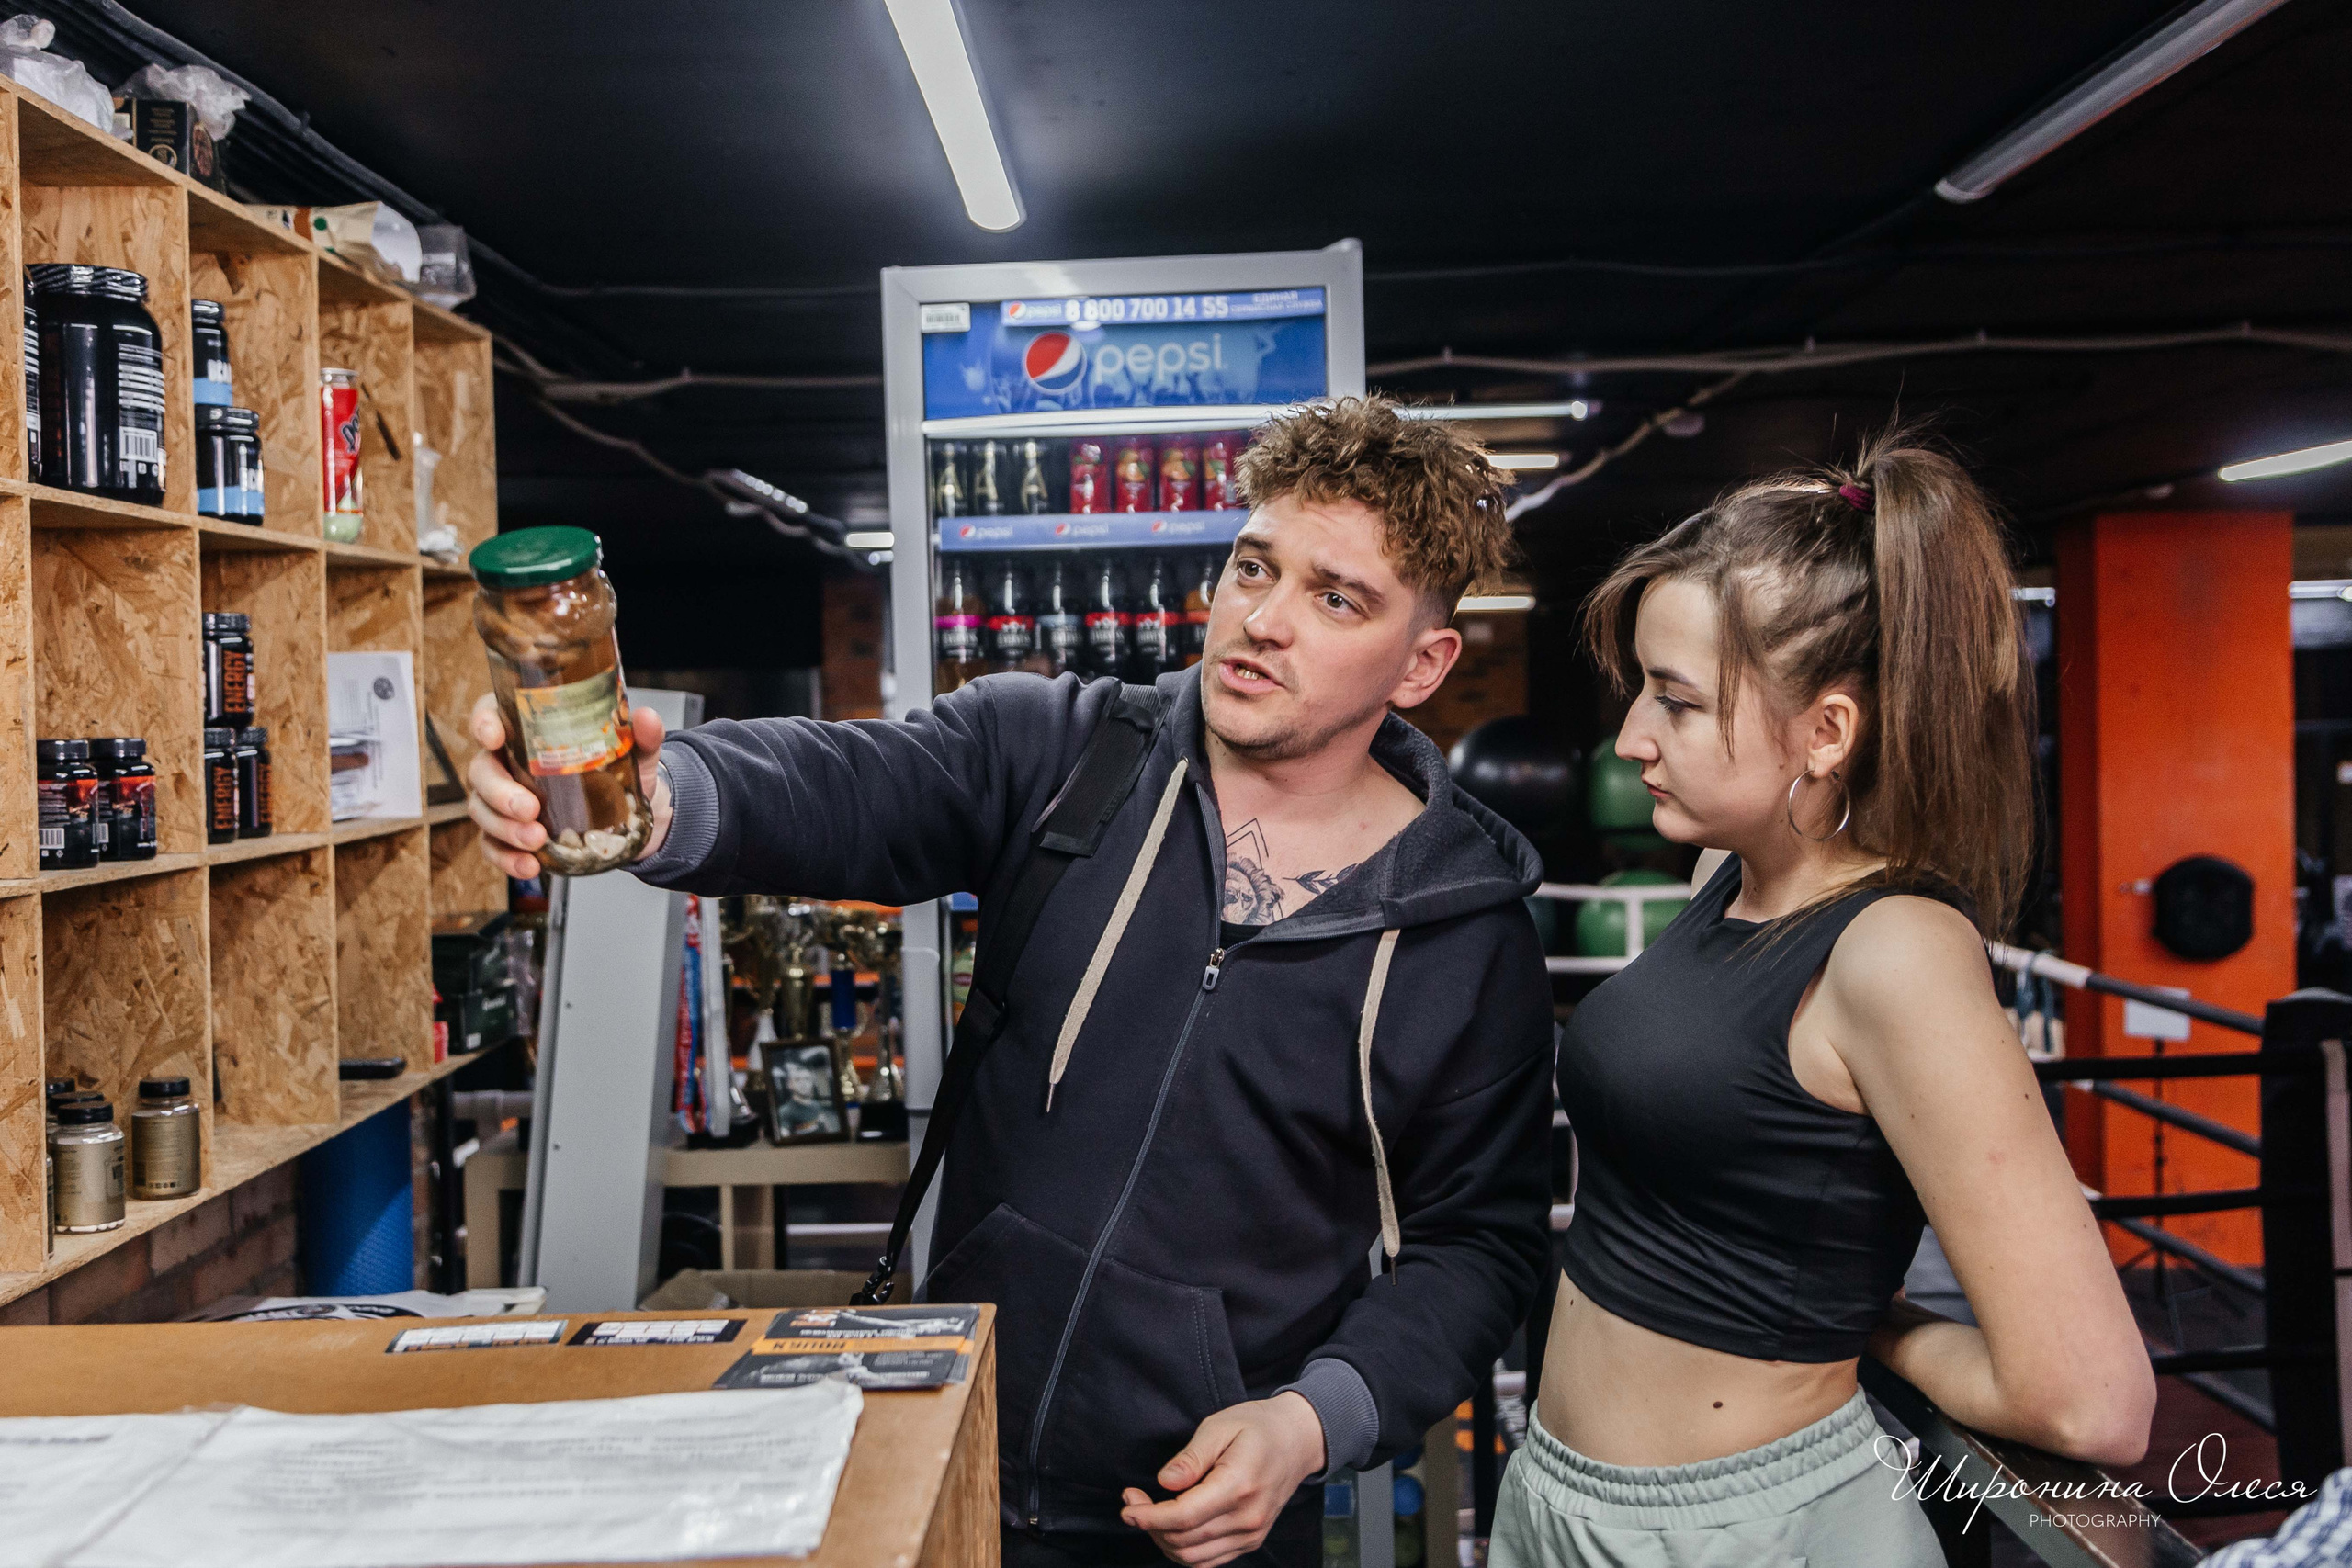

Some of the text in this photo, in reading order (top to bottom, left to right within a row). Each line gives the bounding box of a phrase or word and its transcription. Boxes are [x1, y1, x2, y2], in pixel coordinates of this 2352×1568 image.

[1065, 299, 1080, 321] 8
[1084, 299, 1126, 321] 800
[1130, 297, 1169, 320] 700
[1173, 297, 1197, 318] 14
[1202, 296, 1229, 318] 55
[1095, 333, 1224, 384] pepsi
[977, 526, 1013, 539] pepsi
[1073, 524, 1109, 537] pepsi
[1168, 521, 1205, 534] pepsi
[224, 650, 246, 714] ENERGY
[213, 766, 235, 829] ENERGY
